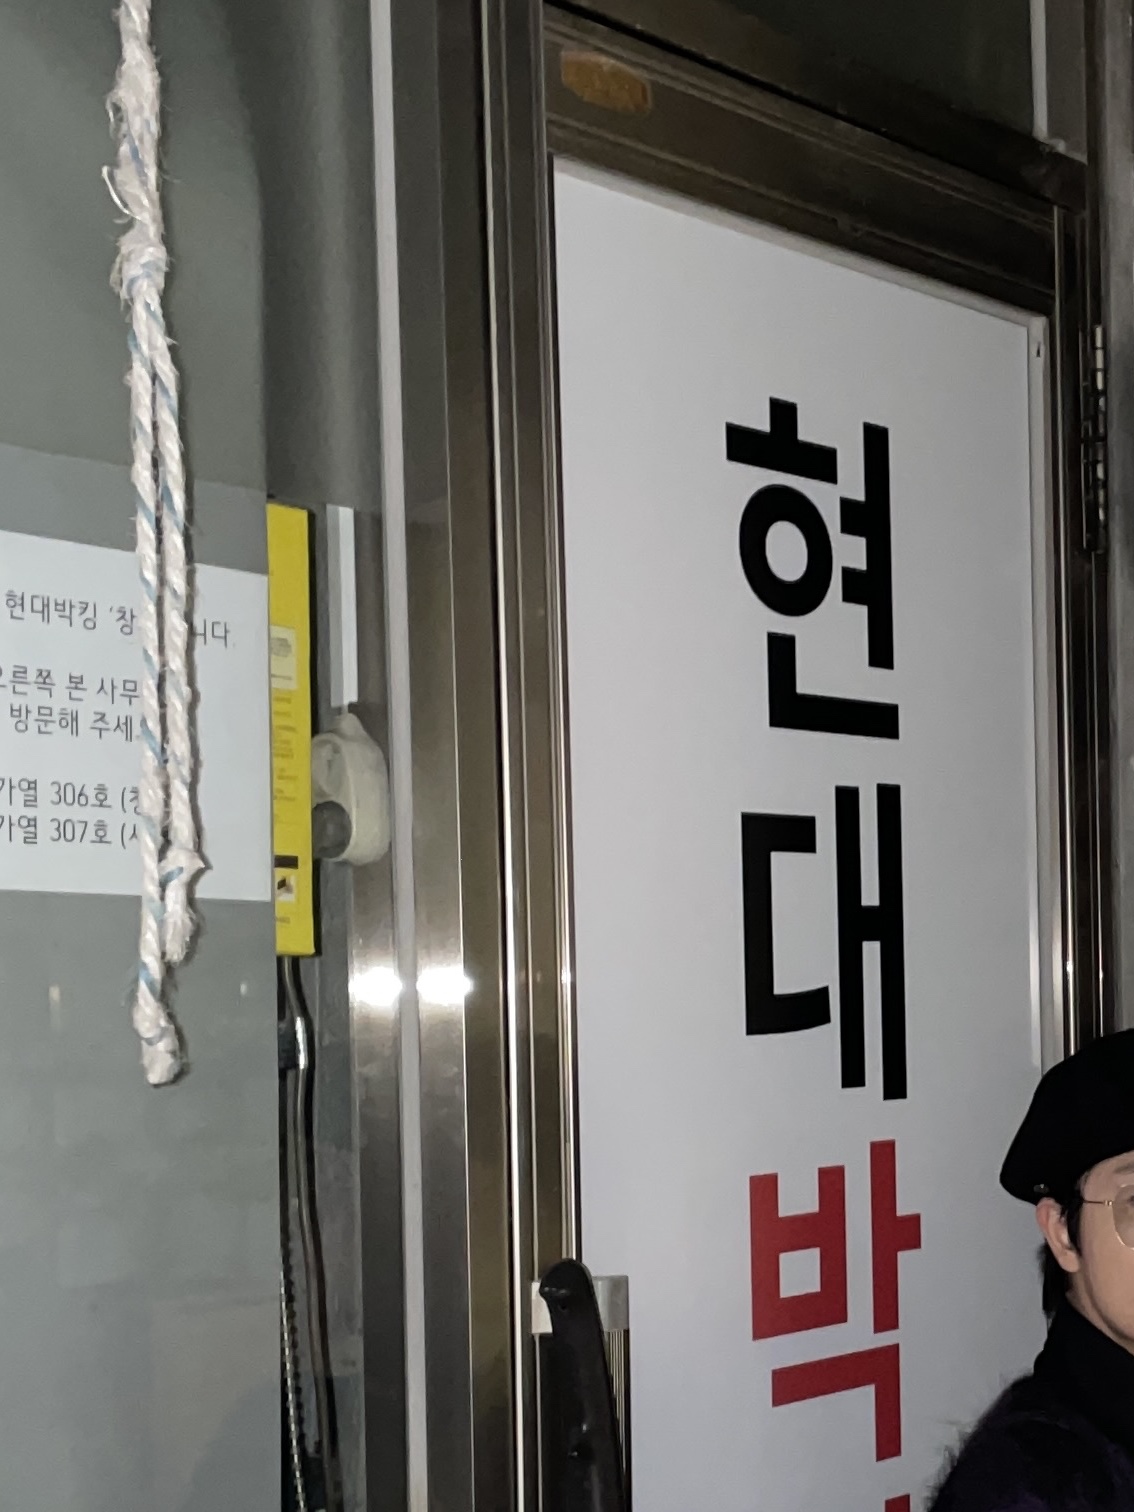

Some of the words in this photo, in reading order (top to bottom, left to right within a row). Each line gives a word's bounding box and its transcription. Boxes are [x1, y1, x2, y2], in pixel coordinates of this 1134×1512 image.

[5, 589, 98, 631] 현대박킹
[65, 672, 88, 702] 본
[96, 677, 141, 706] 사무
[9, 702, 80, 738] 방문해
[89, 711, 141, 743] 주세
[50, 780, 113, 809] 306호
[50, 818, 113, 845] 307호
